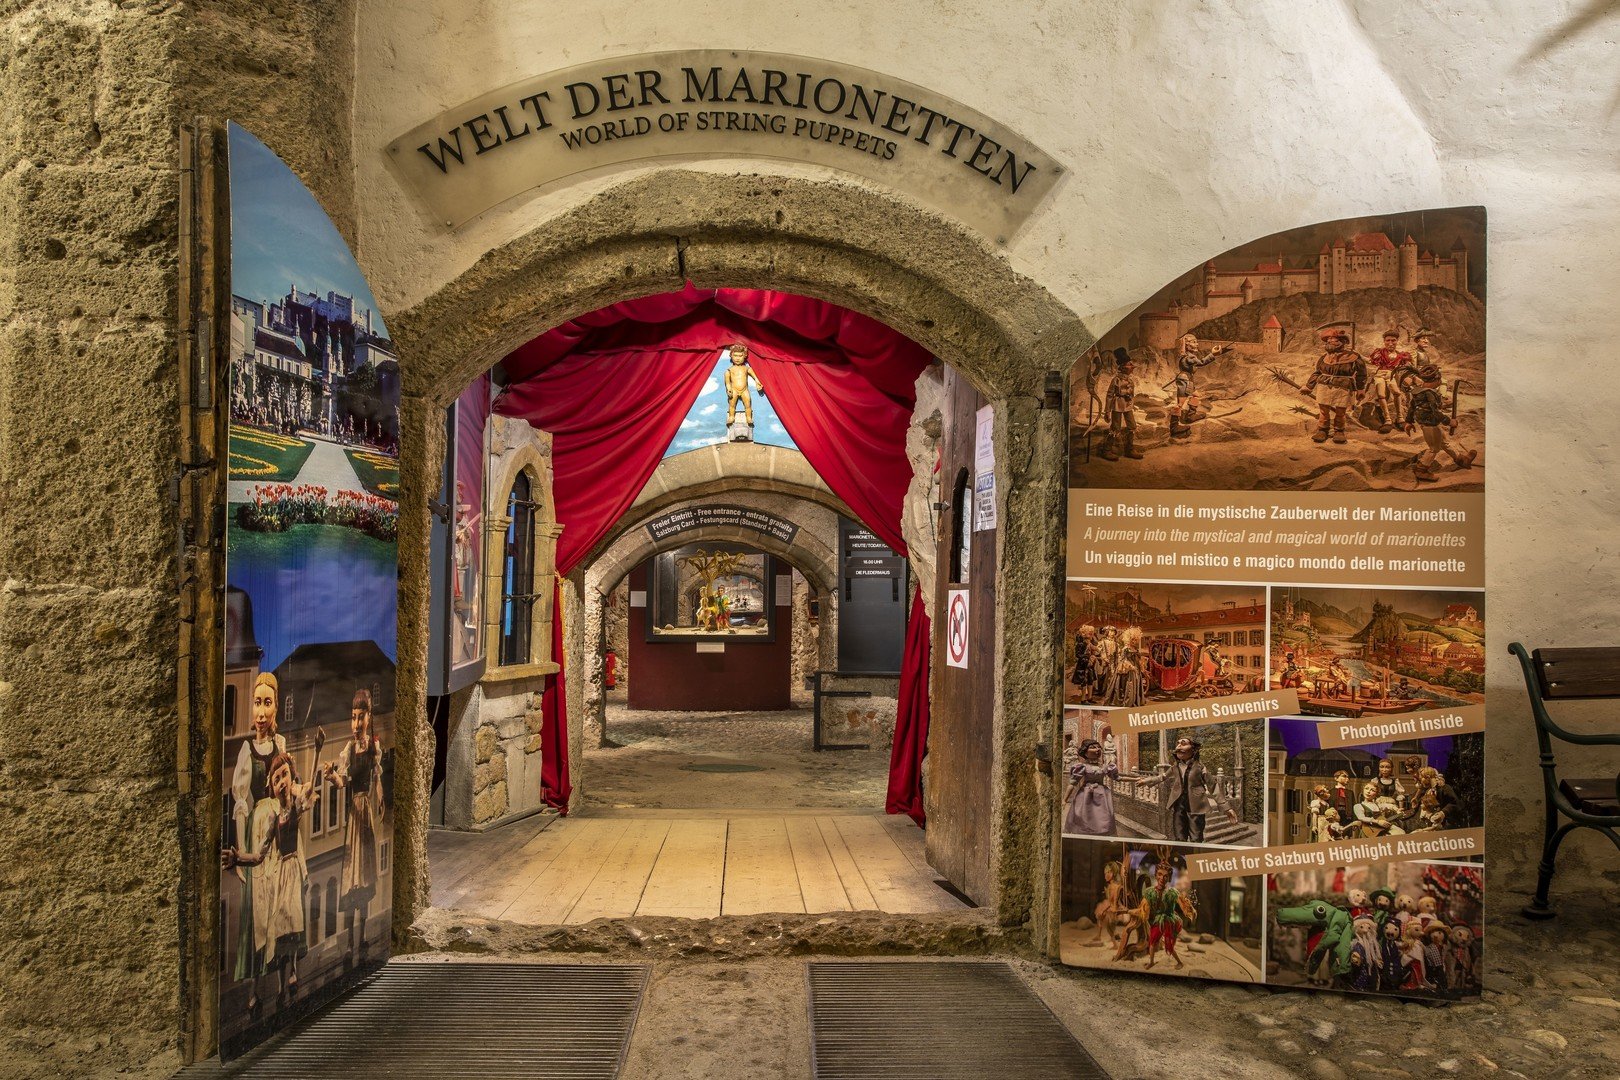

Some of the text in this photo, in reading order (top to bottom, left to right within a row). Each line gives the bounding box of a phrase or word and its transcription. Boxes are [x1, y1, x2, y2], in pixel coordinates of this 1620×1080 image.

[417, 67, 1037, 195] WELT DER MARIONETTEN
[559, 111, 898, 161] WORLD OF STRING PUPPETS
[652, 518, 670, 530] Freier
[671, 511, 693, 523] Eintritt
[697, 508, 712, 517] Free
[713, 508, 741, 516] entrance
[746, 511, 769, 521] entrata
[769, 517, 793, 534] gratuita
[1085, 503, 1466, 522] Eine Reise in die mystische Zauberwelt der Marionetten
[655, 524, 681, 538] Salzburg
[681, 519, 695, 528] Card
[739, 518, 767, 531] (Standard
[1084, 527, 1466, 547] A journey into the mystical and magical world of marionettes
[1085, 551, 1466, 572] Un viaggio nel mistico e magico mondo delle marionette
[1128, 698, 1279, 727] Marionetten Souvenirs
[1340, 714, 1464, 740] Photopoint inside
[1196, 837, 1475, 874] Ticket for Salzburg Highlight Attractions
